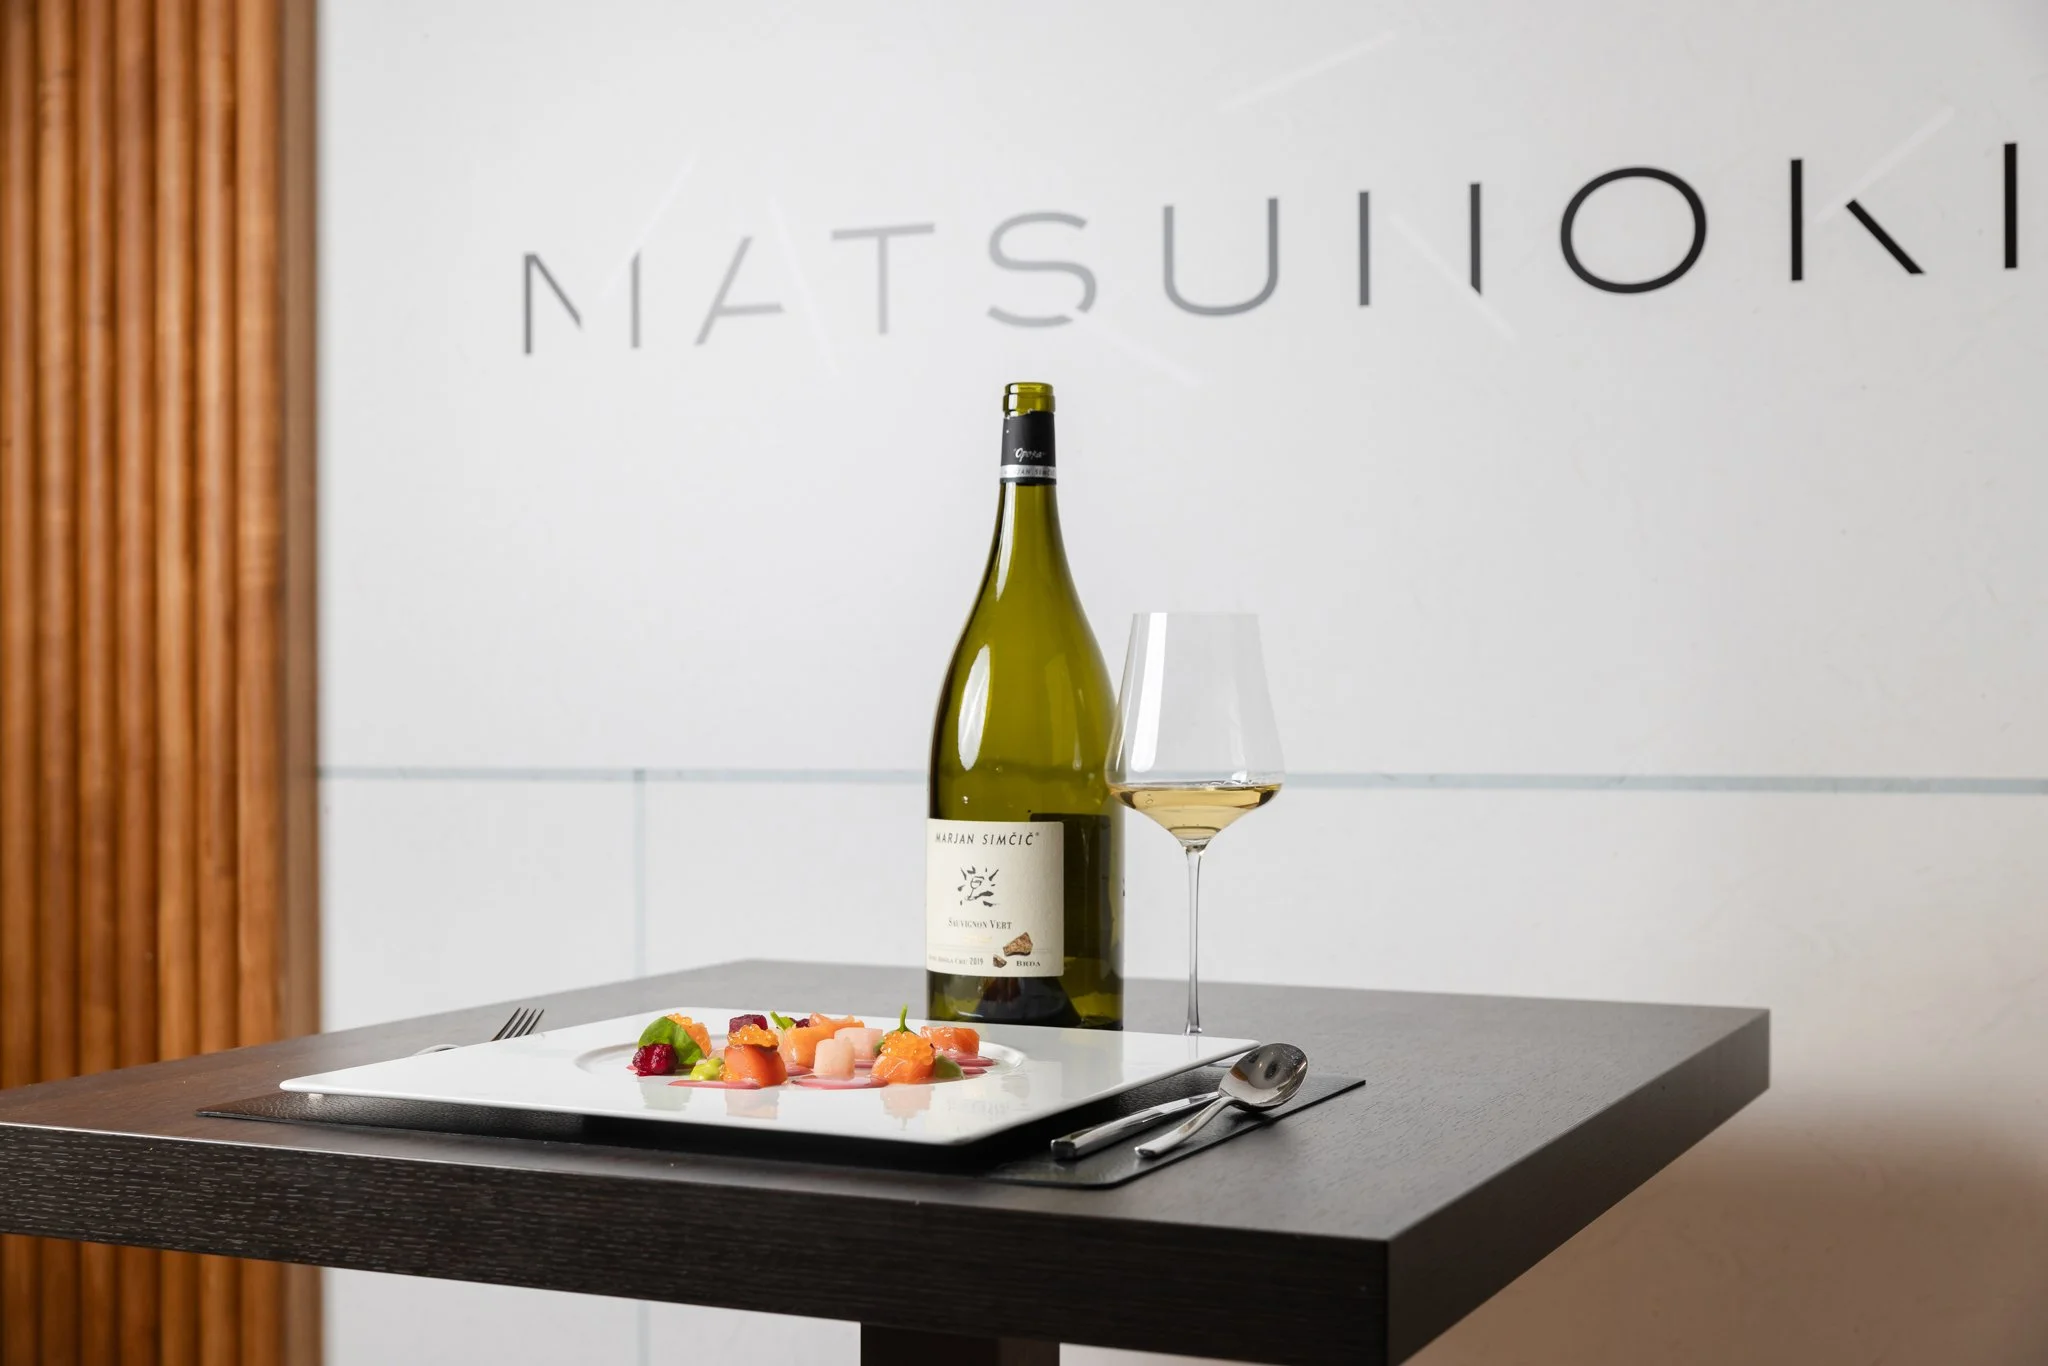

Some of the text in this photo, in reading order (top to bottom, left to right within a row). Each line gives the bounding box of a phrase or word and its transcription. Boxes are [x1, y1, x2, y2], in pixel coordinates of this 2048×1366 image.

[523, 141, 2018, 356] MATSUNOKI
[934, 831, 975, 845] MARJAN
[969, 957, 984, 966] 2019
